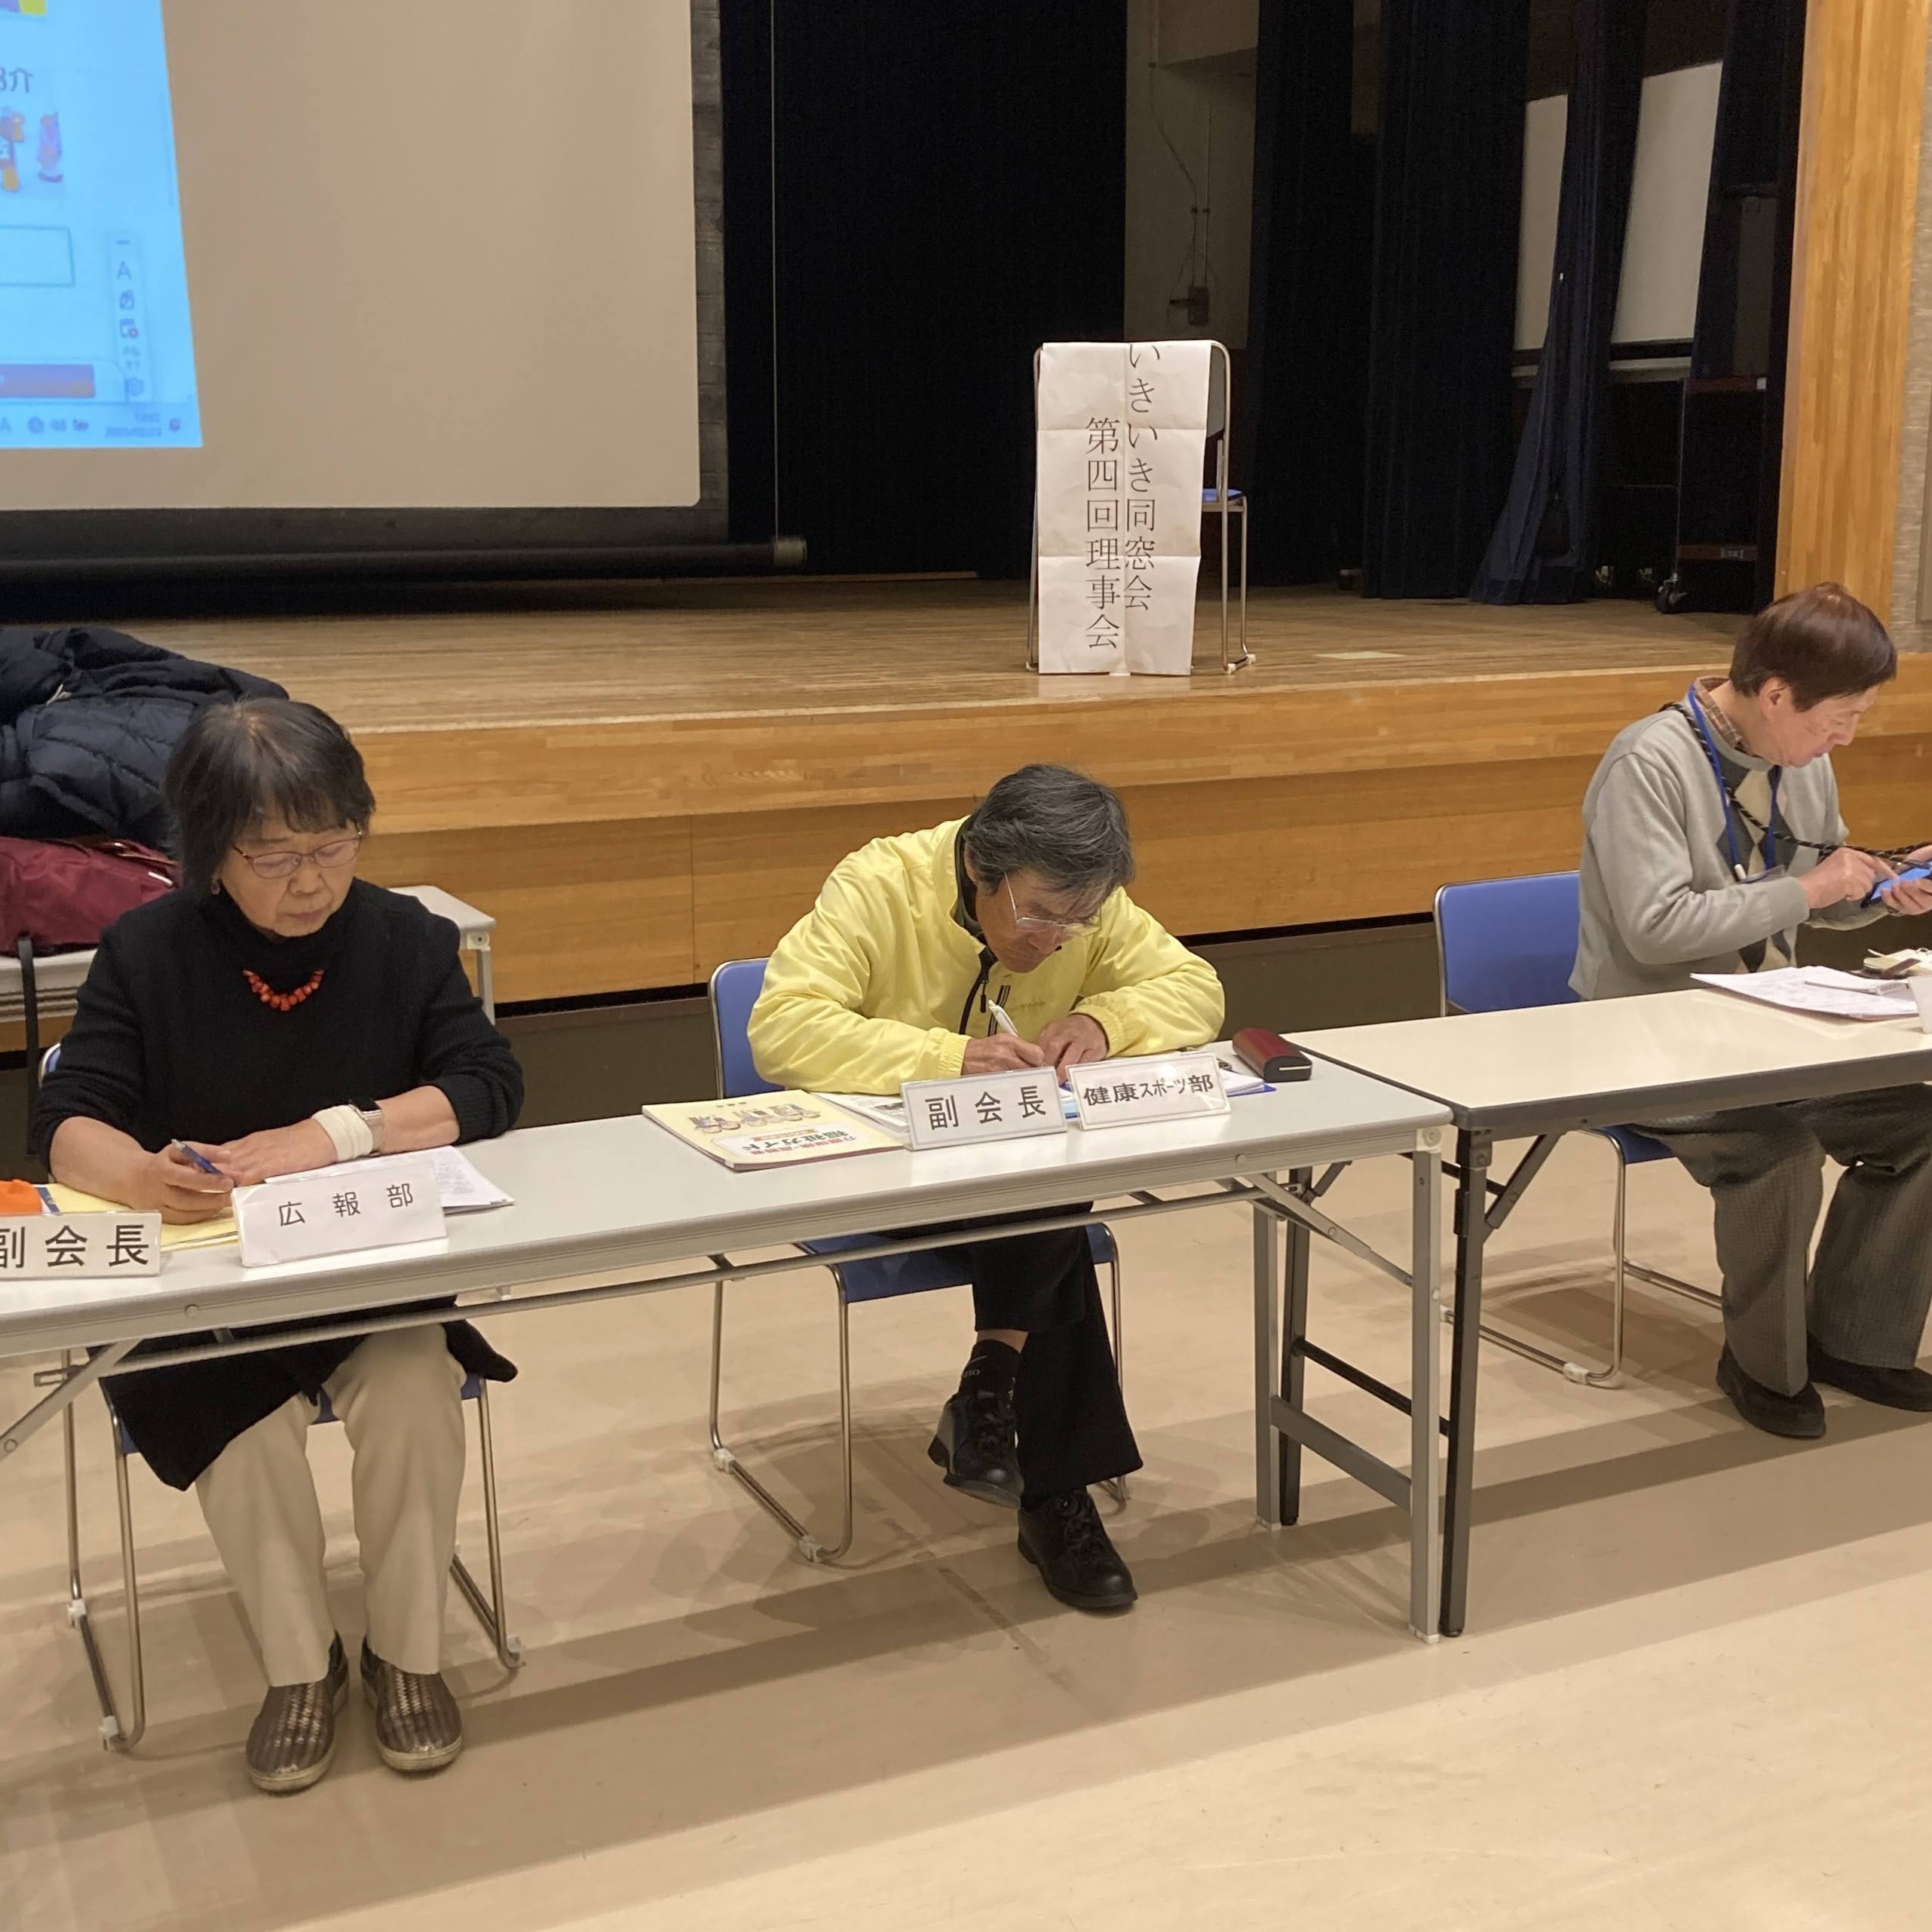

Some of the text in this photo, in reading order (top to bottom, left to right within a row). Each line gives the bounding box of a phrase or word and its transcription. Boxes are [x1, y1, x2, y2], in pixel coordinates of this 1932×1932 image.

[0, 66, 34, 93] 介
[1123, 344, 1161, 611] いきいき同窓会
[1085, 417, 1121, 649] 第四回理事会
[925, 1085, 1046, 1130] 副会長
[1083, 1074, 1214, 1107] 健康スポーツ部
[279, 1183, 414, 1227] 広報部
[0, 1225, 149, 1269] 副会長
